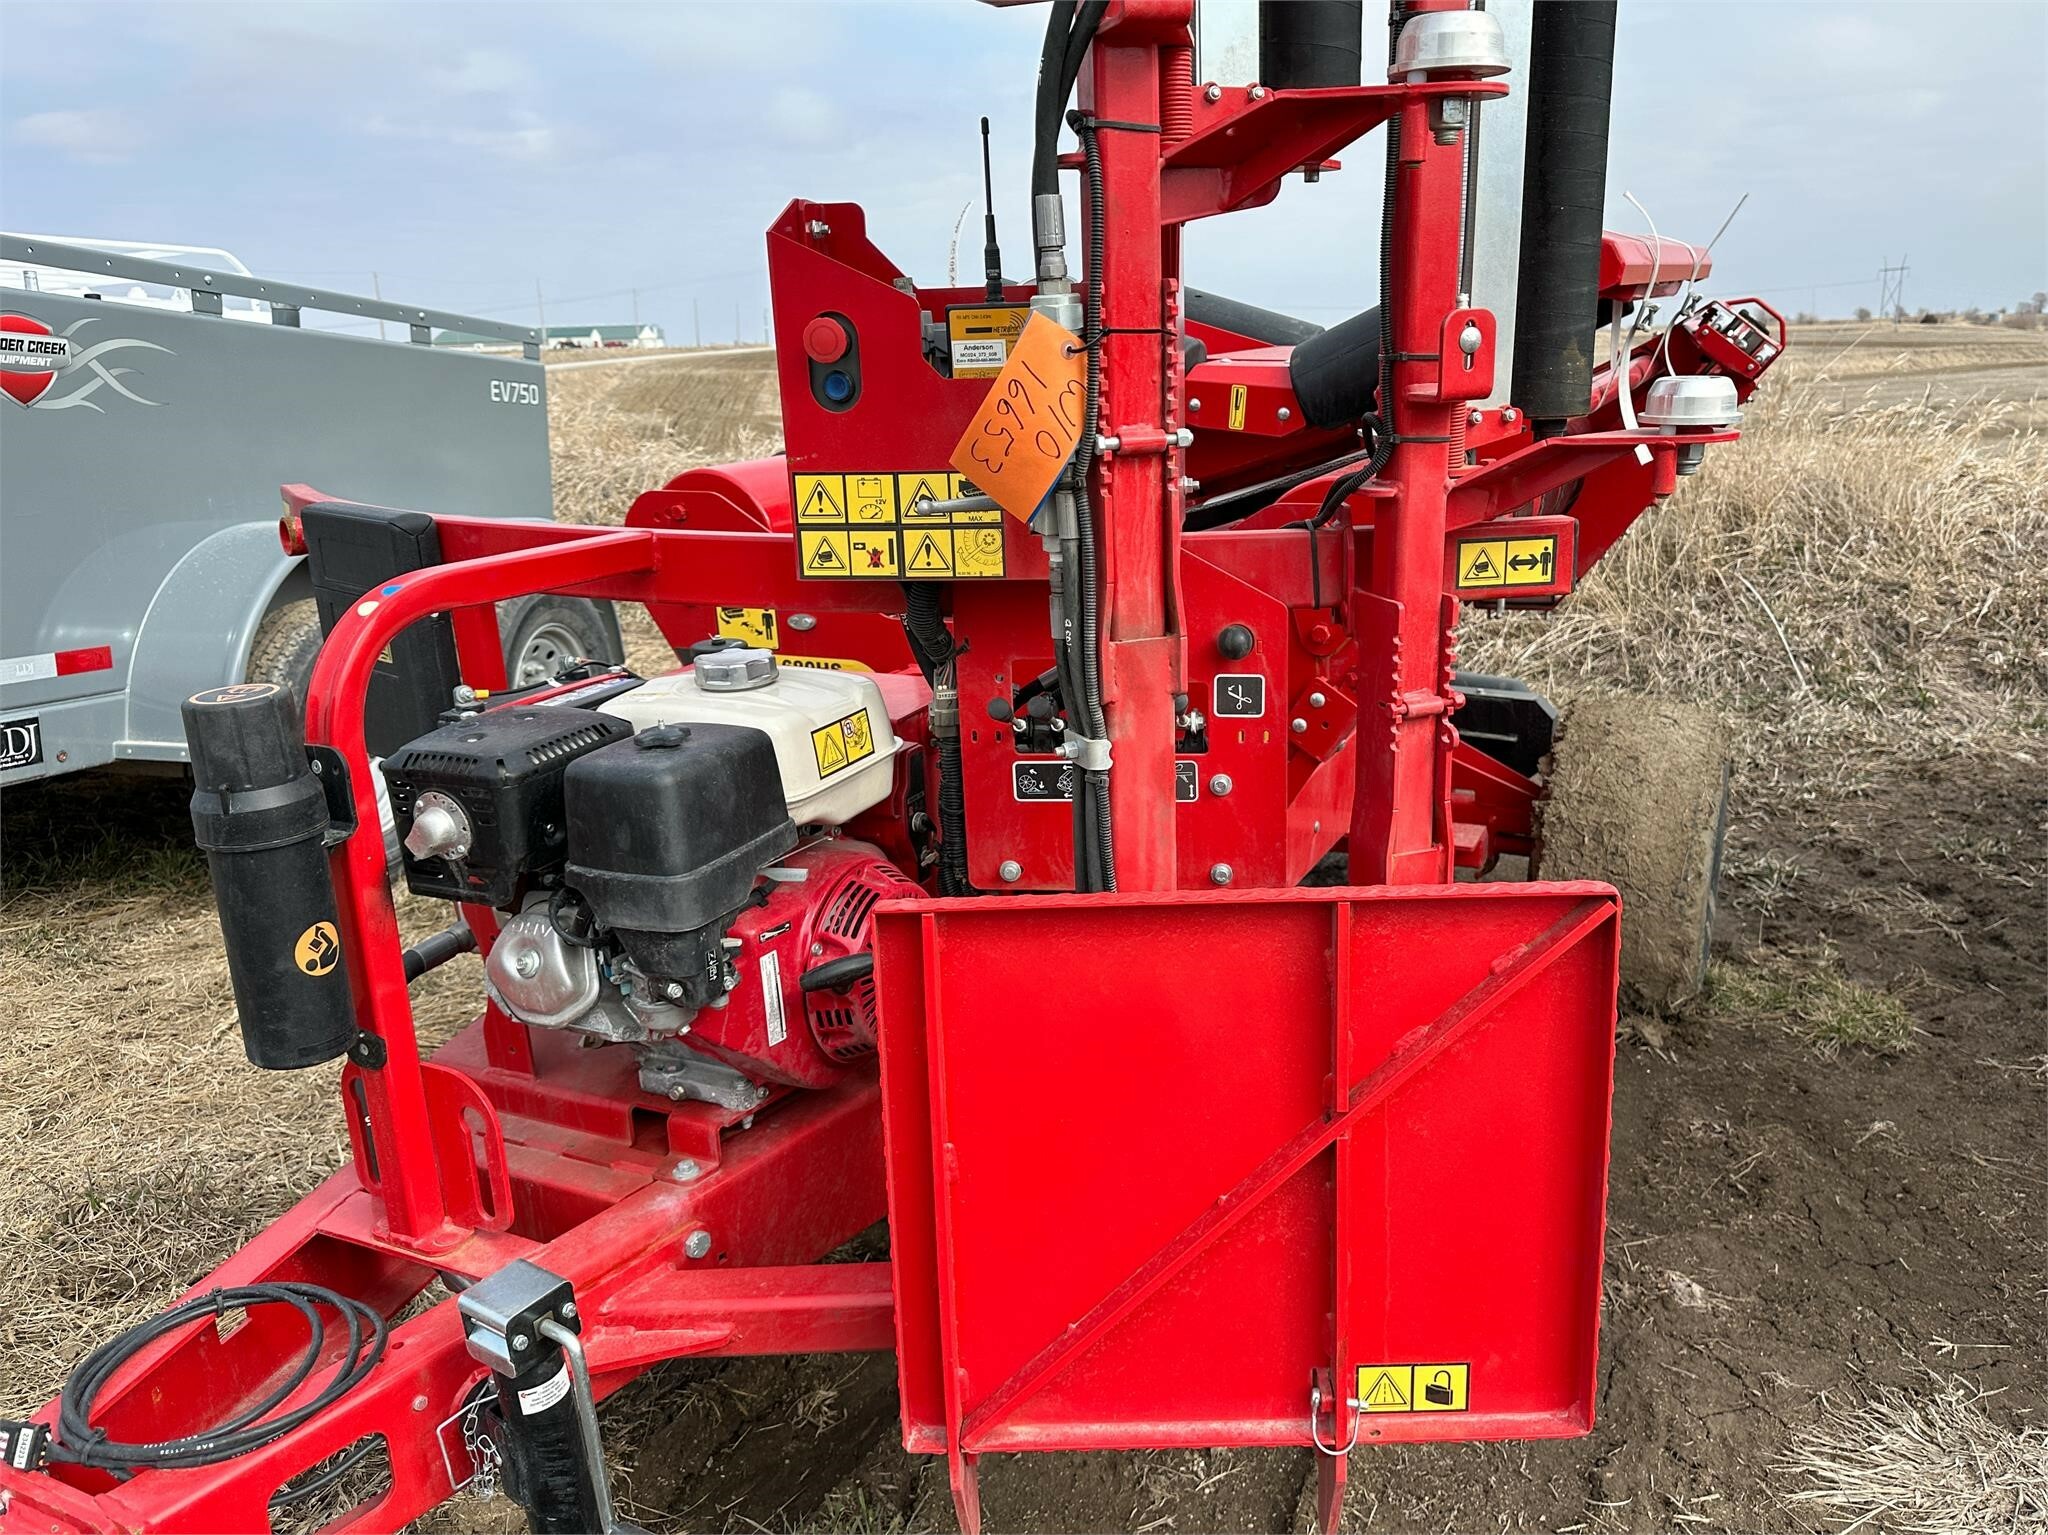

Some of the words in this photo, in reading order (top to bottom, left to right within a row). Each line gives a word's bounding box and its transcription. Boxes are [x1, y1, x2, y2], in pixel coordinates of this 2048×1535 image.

[28, 340, 66, 355] CREEK
[490, 380, 540, 405] EV750
[970, 361, 1047, 474] 16653
[196, 1442, 214, 1450] SAE
